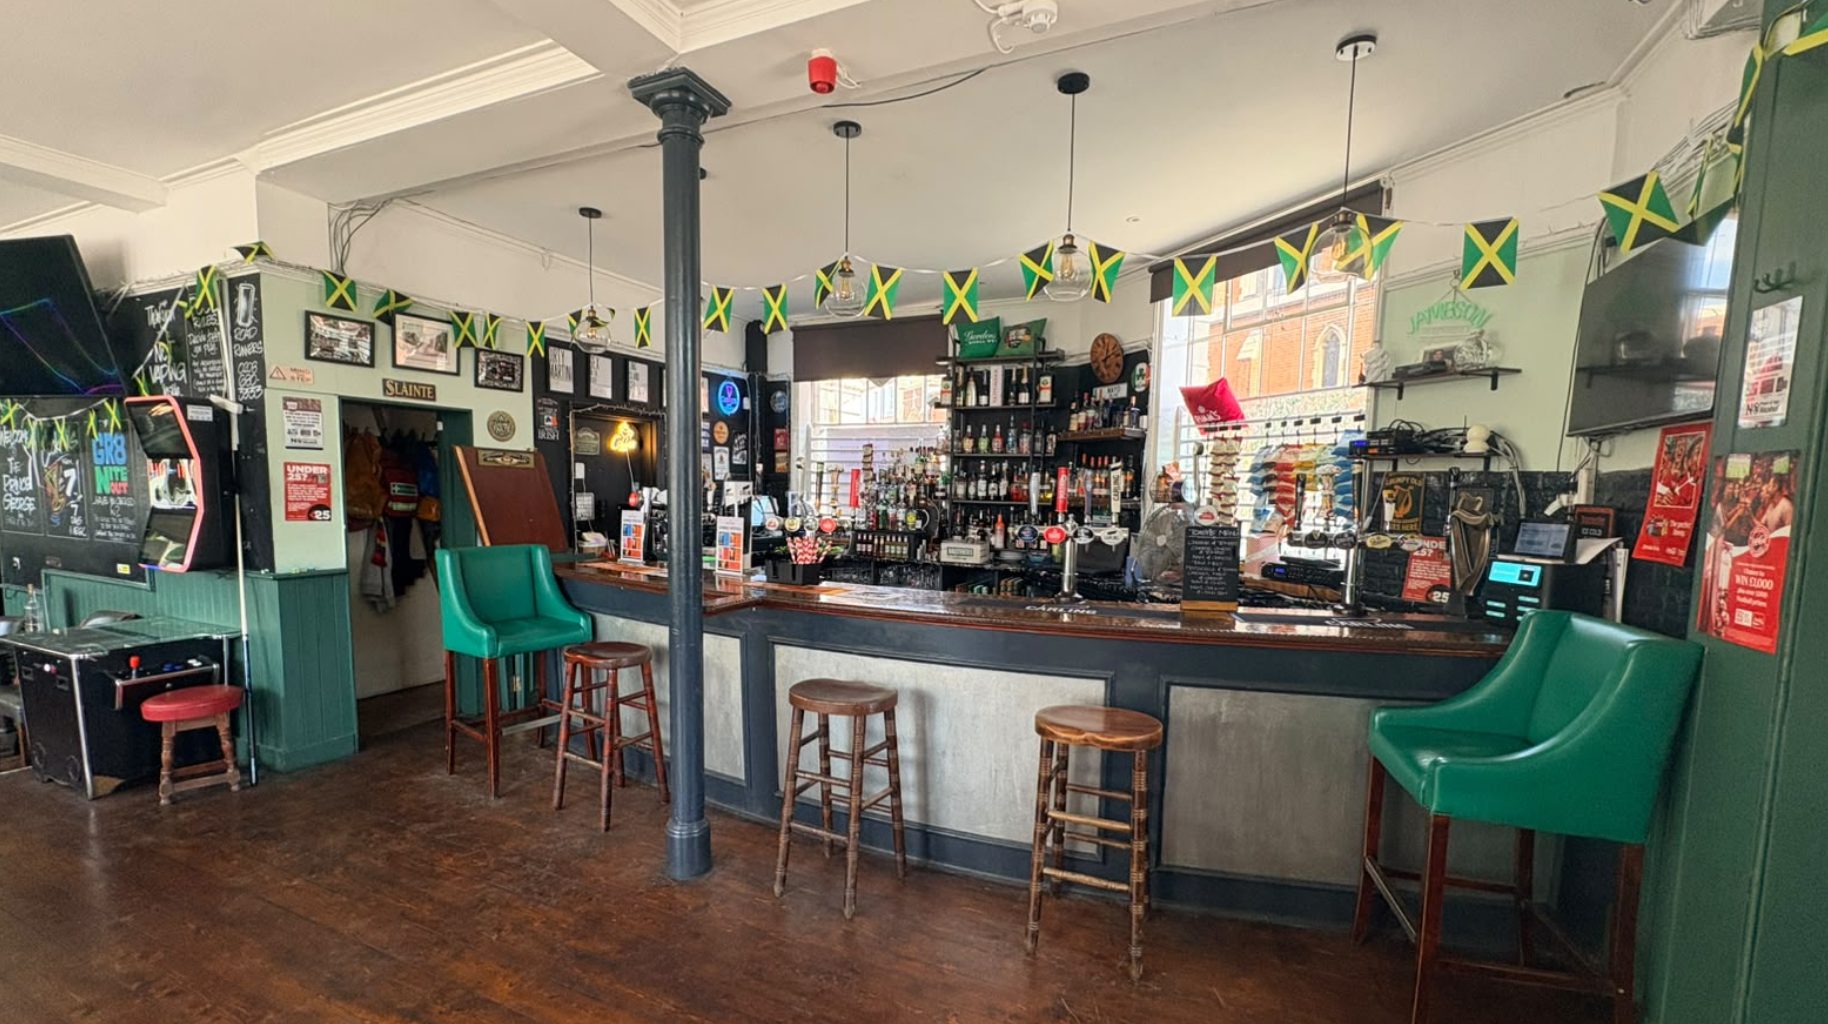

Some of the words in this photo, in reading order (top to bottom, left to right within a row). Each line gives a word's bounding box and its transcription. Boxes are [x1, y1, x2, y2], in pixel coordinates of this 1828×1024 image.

[149, 362, 187, 385] VAPNG
[92, 432, 128, 465] GR8
[286, 464, 328, 475] UNDER
[314, 509, 331, 520] 25
[1735, 574, 1748, 586] WIN
[1432, 591, 1450, 604] 25
